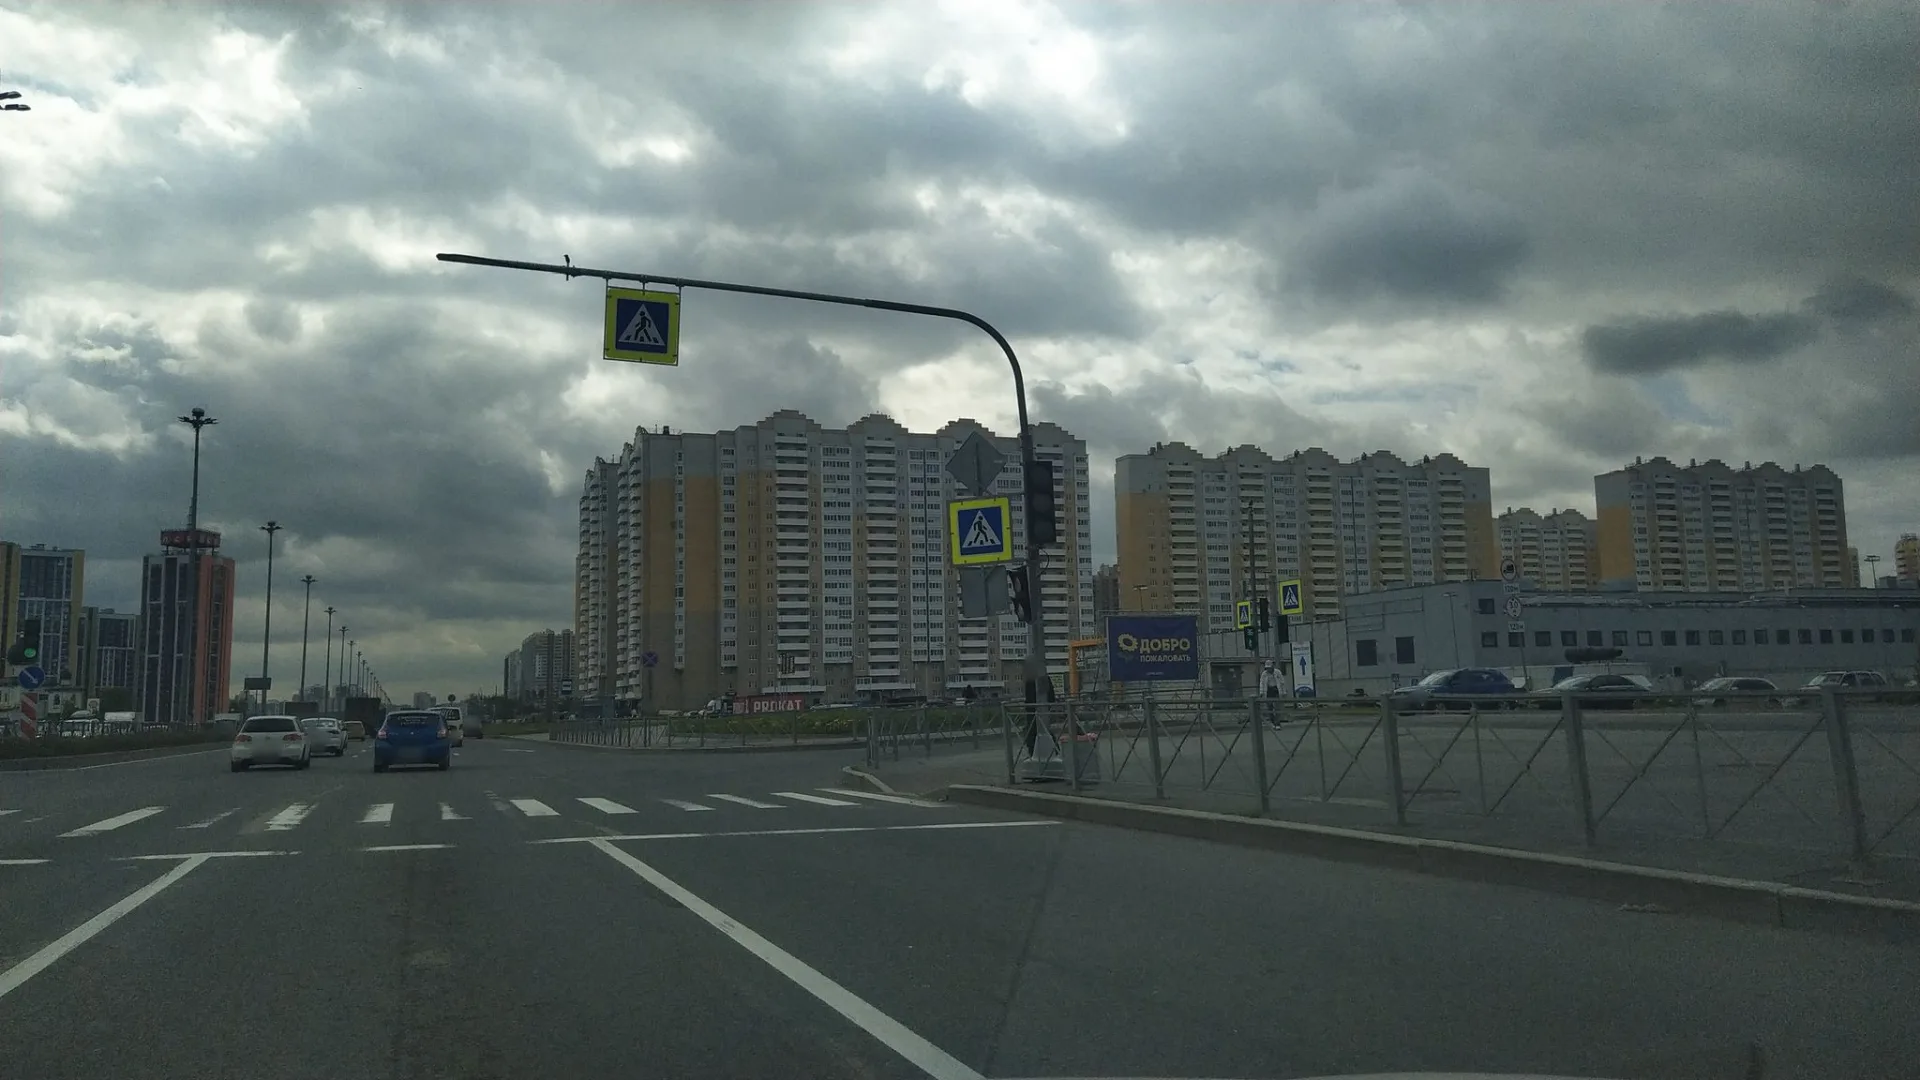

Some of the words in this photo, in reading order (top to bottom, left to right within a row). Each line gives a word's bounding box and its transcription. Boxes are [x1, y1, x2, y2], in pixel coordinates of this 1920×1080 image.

[1139, 638, 1191, 654] ДОБРО
[1140, 655, 1191, 663] ПОЖАЛОВАТЬ
[753, 700, 802, 713] PROKAT
